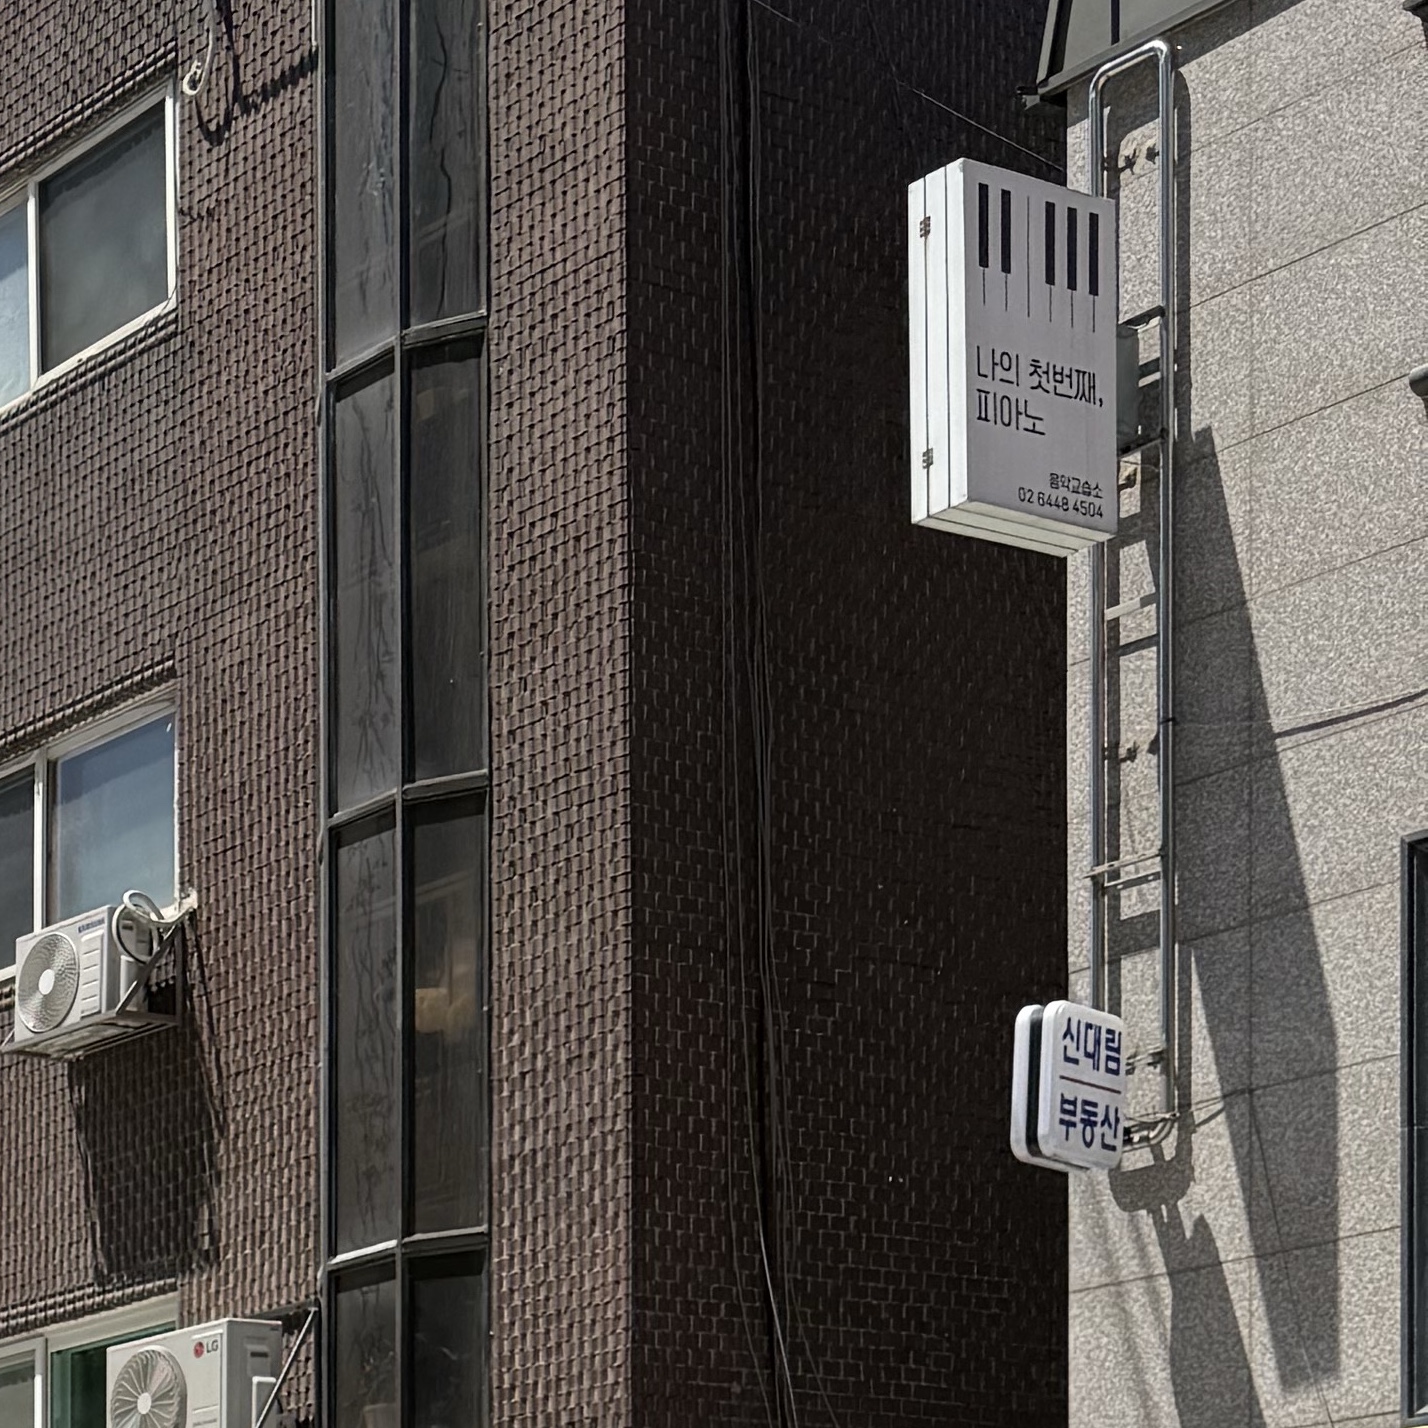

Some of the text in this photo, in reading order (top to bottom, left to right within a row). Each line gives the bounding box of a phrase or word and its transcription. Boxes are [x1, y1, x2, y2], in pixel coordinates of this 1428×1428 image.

[976, 345, 1104, 408] 나의 첫번째,
[976, 388, 1046, 435] 피아노
[1018, 487, 1104, 519] 02 6448 4504
[1049, 472, 1104, 499] 음악교습소
[1062, 1017, 1122, 1076] 신대림
[1059, 1092, 1120, 1152] 부동산
